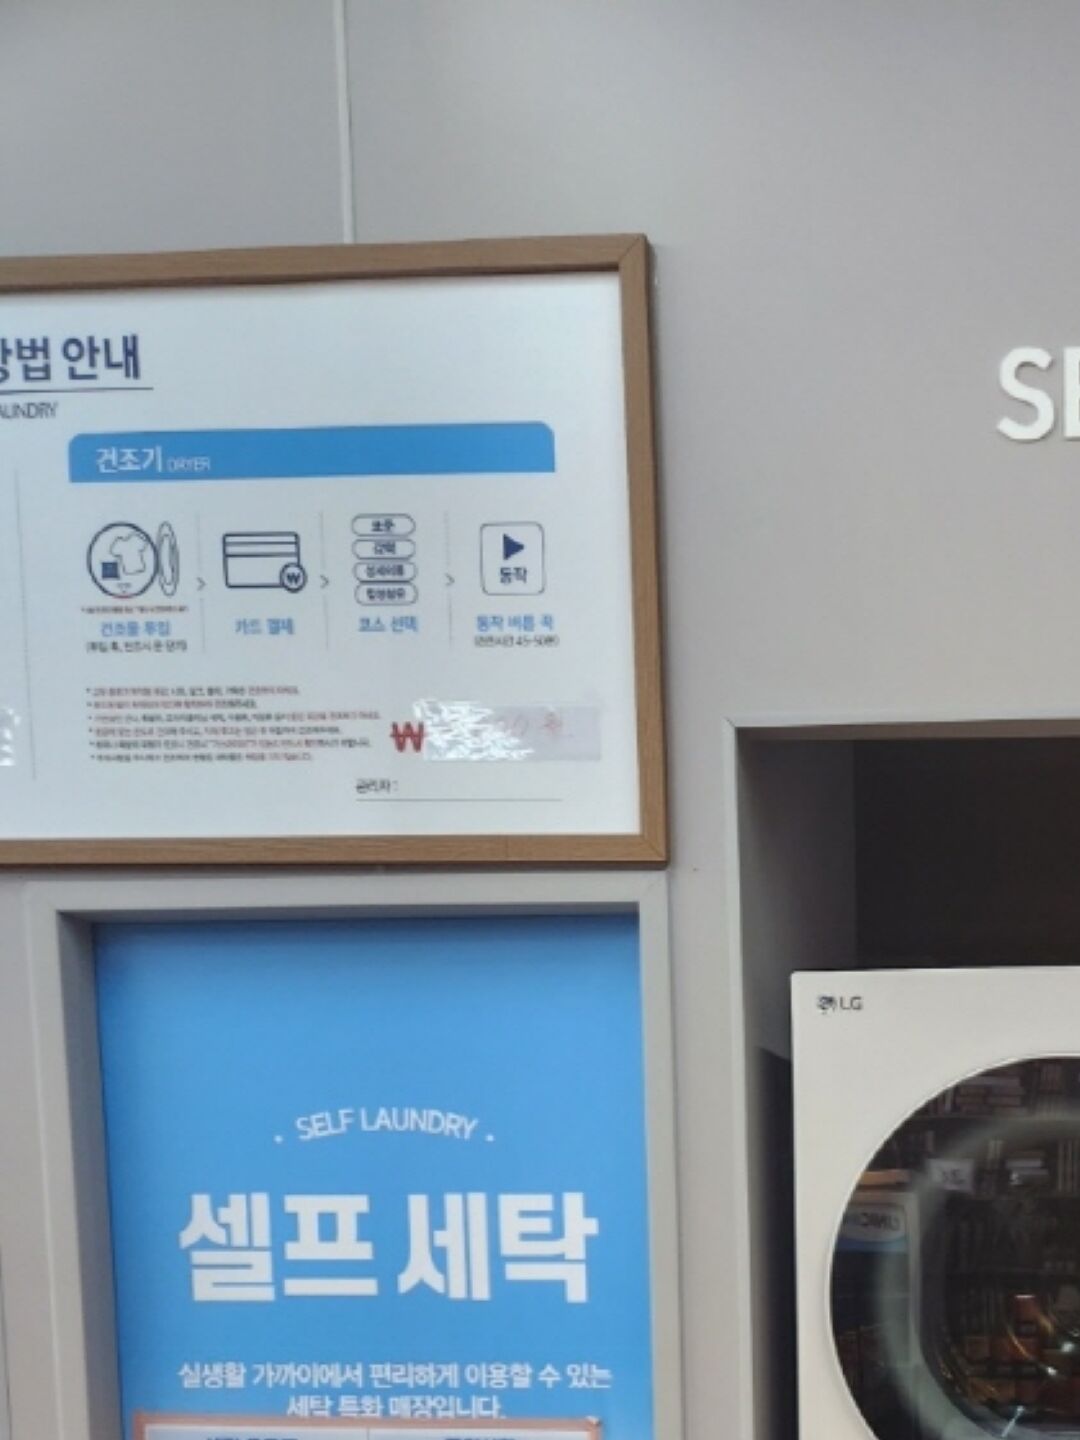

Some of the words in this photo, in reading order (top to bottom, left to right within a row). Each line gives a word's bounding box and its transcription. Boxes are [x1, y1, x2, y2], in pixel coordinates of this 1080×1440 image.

[62, 334, 140, 380] 안내
[96, 446, 162, 472] 건조기
[167, 457, 210, 472] DRYER
[499, 567, 527, 584] 동작
[840, 996, 863, 1010] LG
[296, 1108, 354, 1140] SELF
[360, 1107, 478, 1140] LAUNDRY
[178, 1192, 378, 1302] 셀프
[397, 1191, 599, 1303] 세탁
[178, 1362, 245, 1390] 실생활
[252, 1362, 363, 1389] 가까이에서
[369, 1362, 460, 1389] 편리하게
[464, 1362, 531, 1389] 이용할
[538, 1363, 561, 1388] 수
[566, 1362, 612, 1390] 있는
[286, 1395, 331, 1418] 세탁
[338, 1395, 384, 1418] 특화
